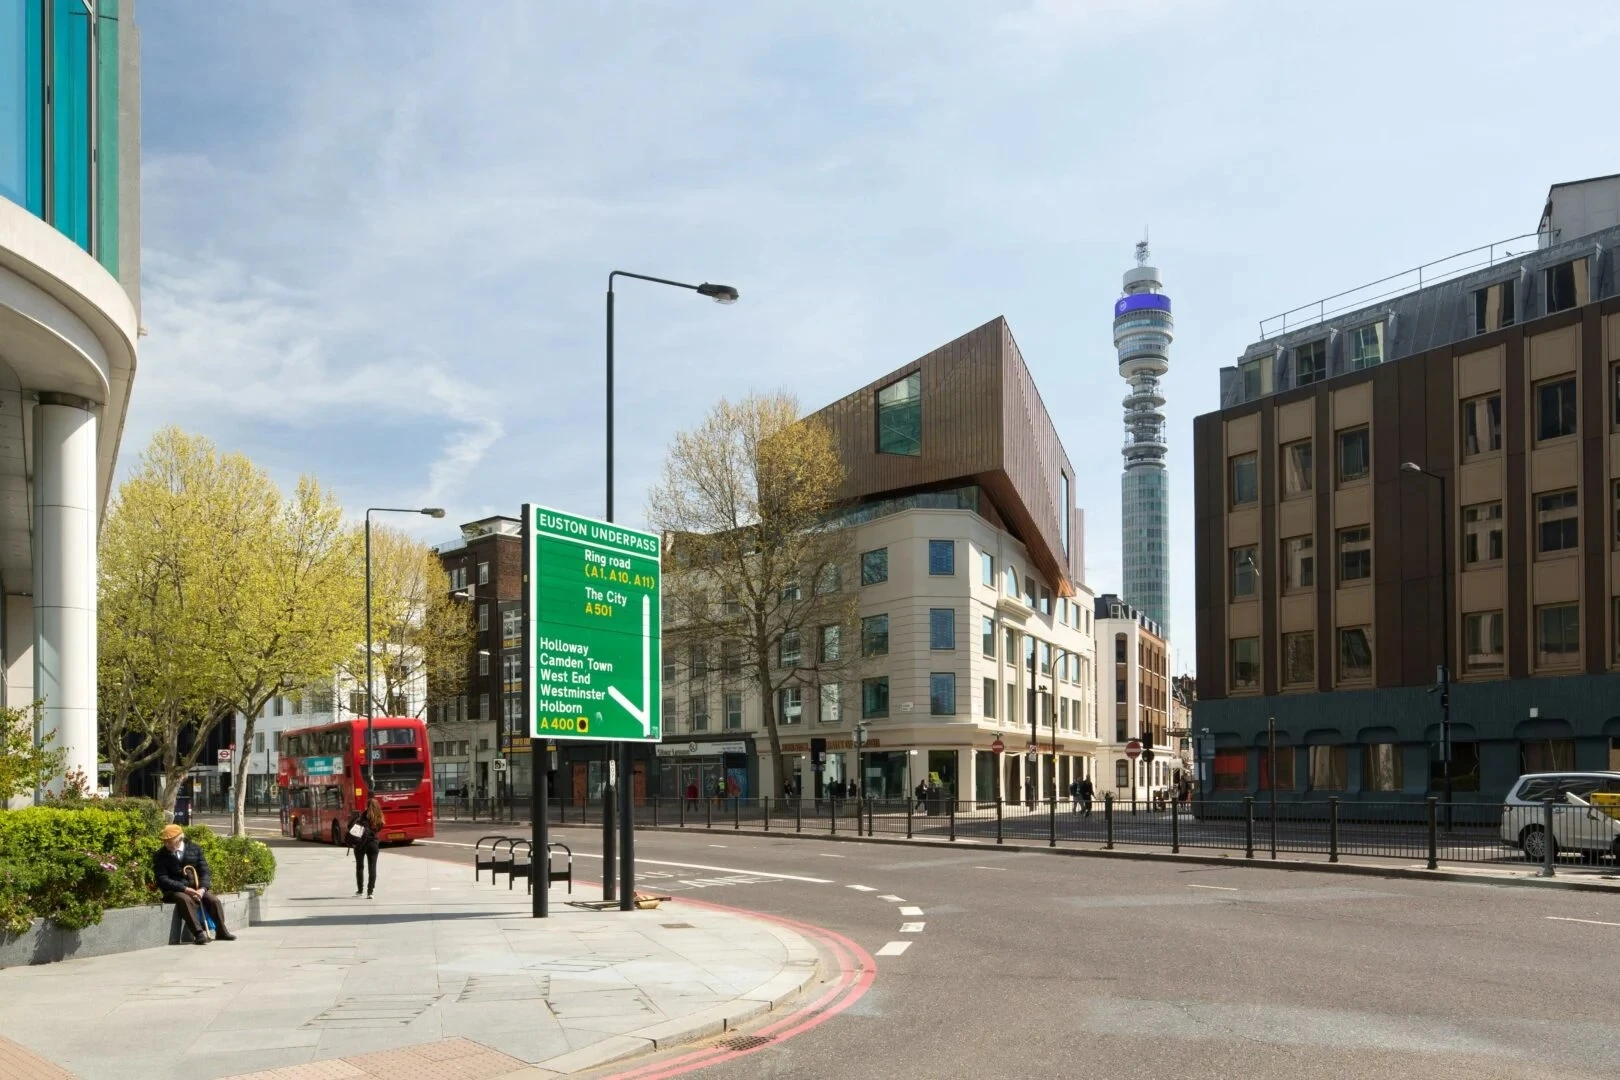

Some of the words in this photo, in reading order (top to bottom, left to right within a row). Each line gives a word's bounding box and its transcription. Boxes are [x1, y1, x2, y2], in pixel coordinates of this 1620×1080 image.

[540, 513, 588, 536] EUSTON
[591, 525, 657, 552] UNDERPASS
[585, 549, 606, 567] Ring
[609, 557, 631, 570] road
[585, 586, 603, 601] The
[606, 590, 628, 607] City
[540, 636, 589, 656] Holloway
[540, 653, 584, 669] Camden
[587, 658, 613, 672] Town
[540, 668, 568, 683] West
[571, 671, 591, 685] End
[540, 683, 606, 700] Westminster
[540, 699, 583, 714] Holborn
